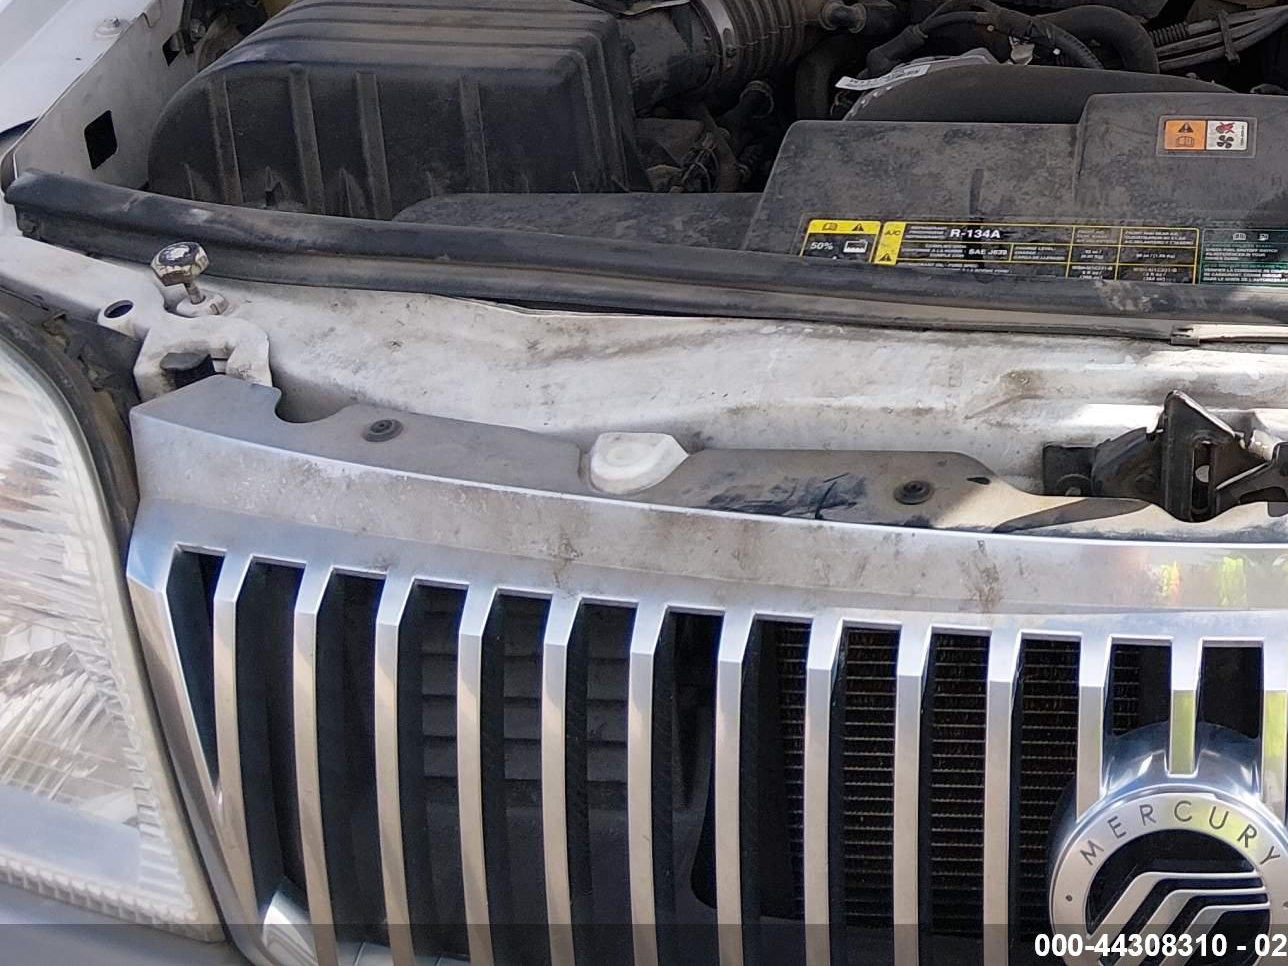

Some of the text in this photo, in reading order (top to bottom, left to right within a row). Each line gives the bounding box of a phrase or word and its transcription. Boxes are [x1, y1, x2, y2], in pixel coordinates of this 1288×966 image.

[949, 229, 1001, 239] R-134A
[810, 241, 834, 250] 50%
[1080, 800, 1281, 866] MERCURY
